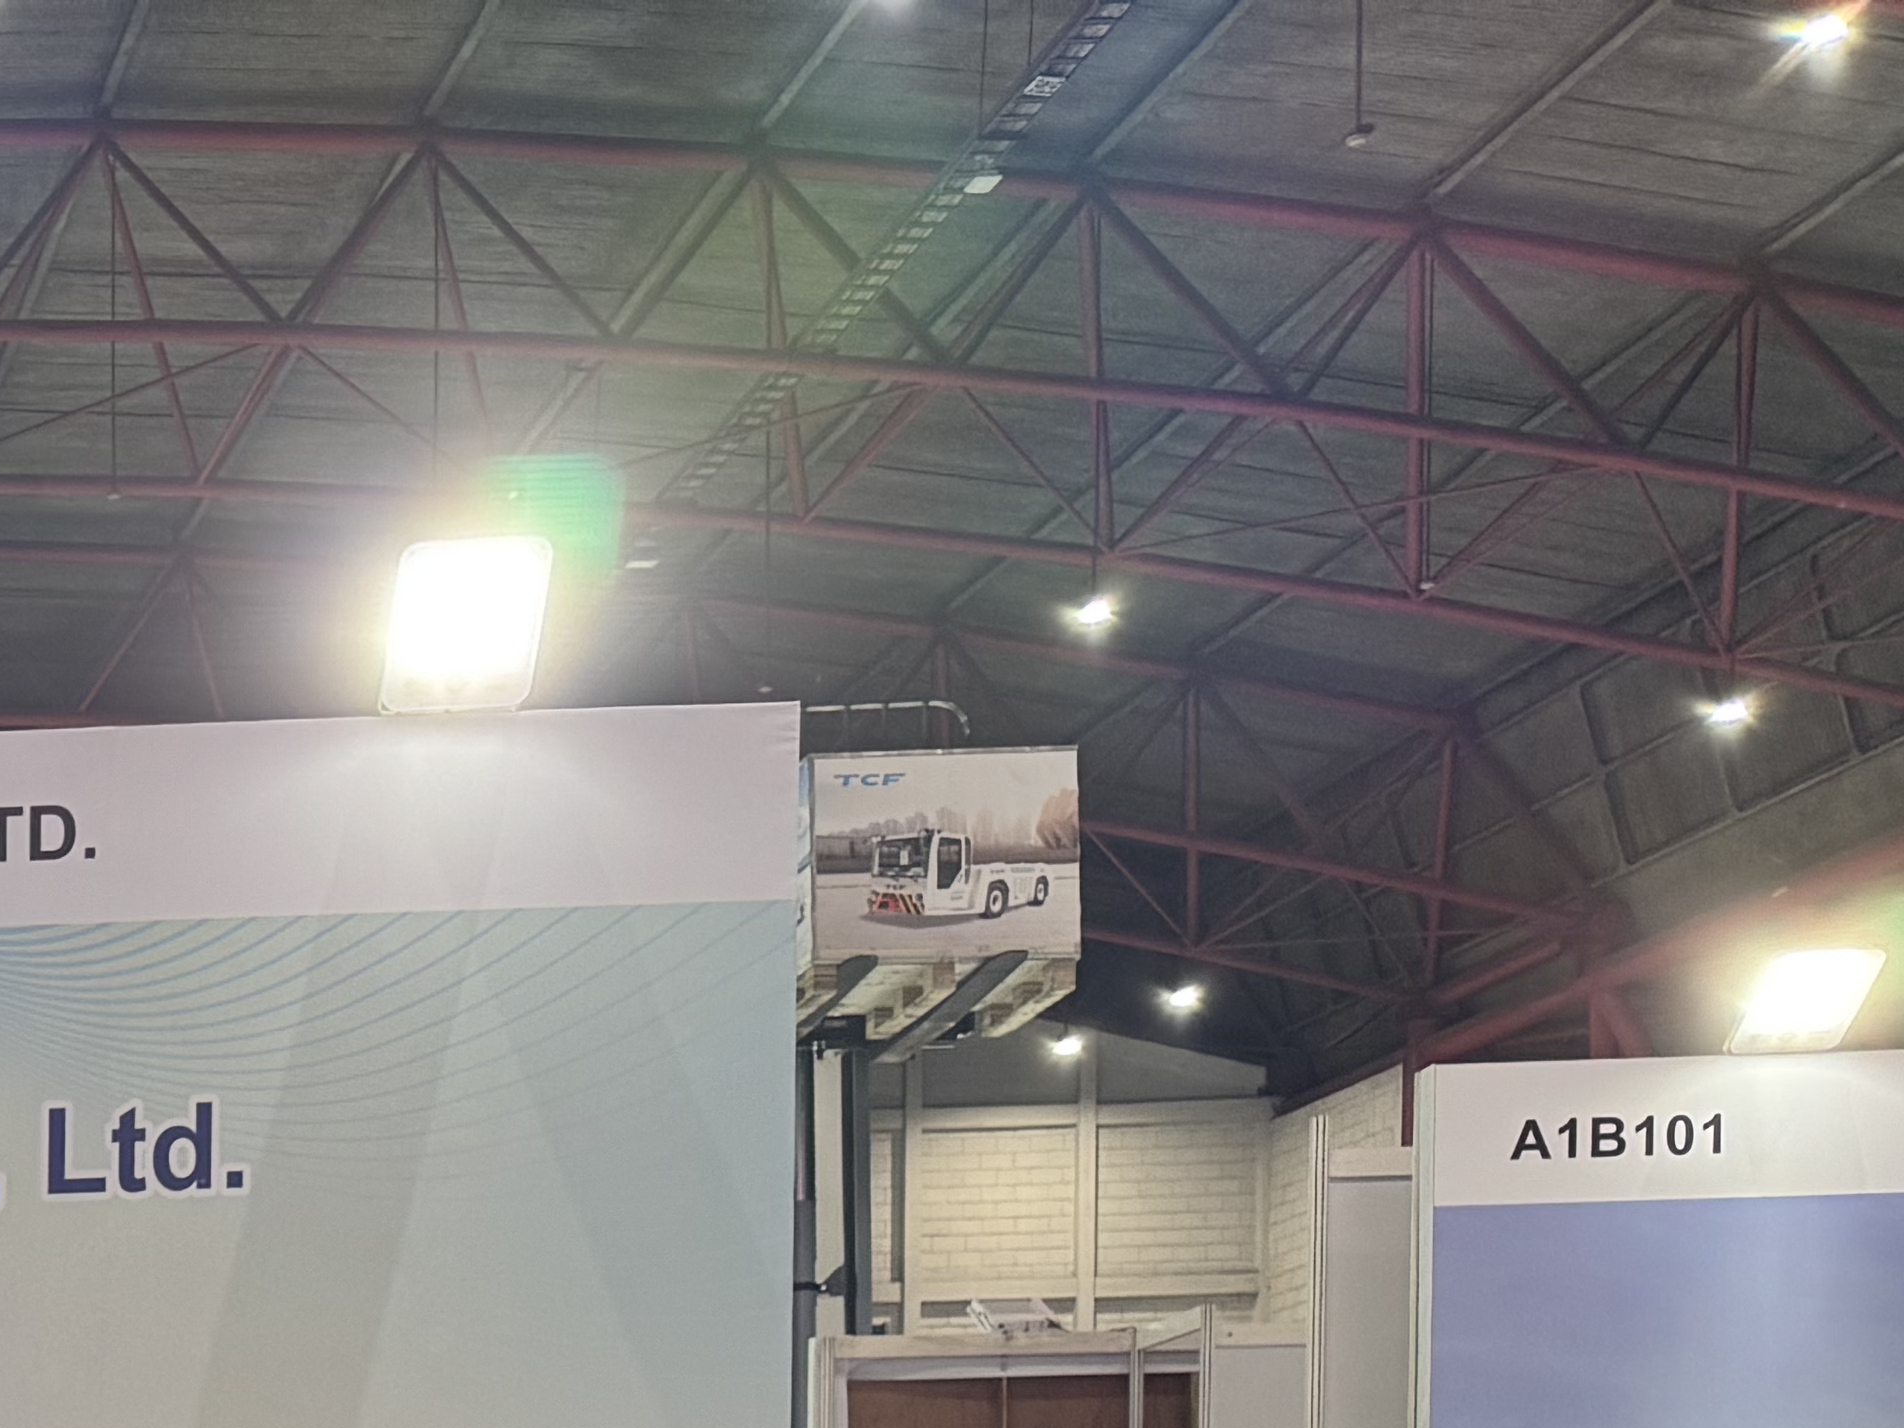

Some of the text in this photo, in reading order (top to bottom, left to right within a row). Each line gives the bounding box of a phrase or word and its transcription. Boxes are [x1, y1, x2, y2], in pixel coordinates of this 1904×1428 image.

[833, 773, 906, 788] TCF
[47, 1101, 244, 1195] Ltd.
[1509, 1112, 1722, 1162] A1B101
